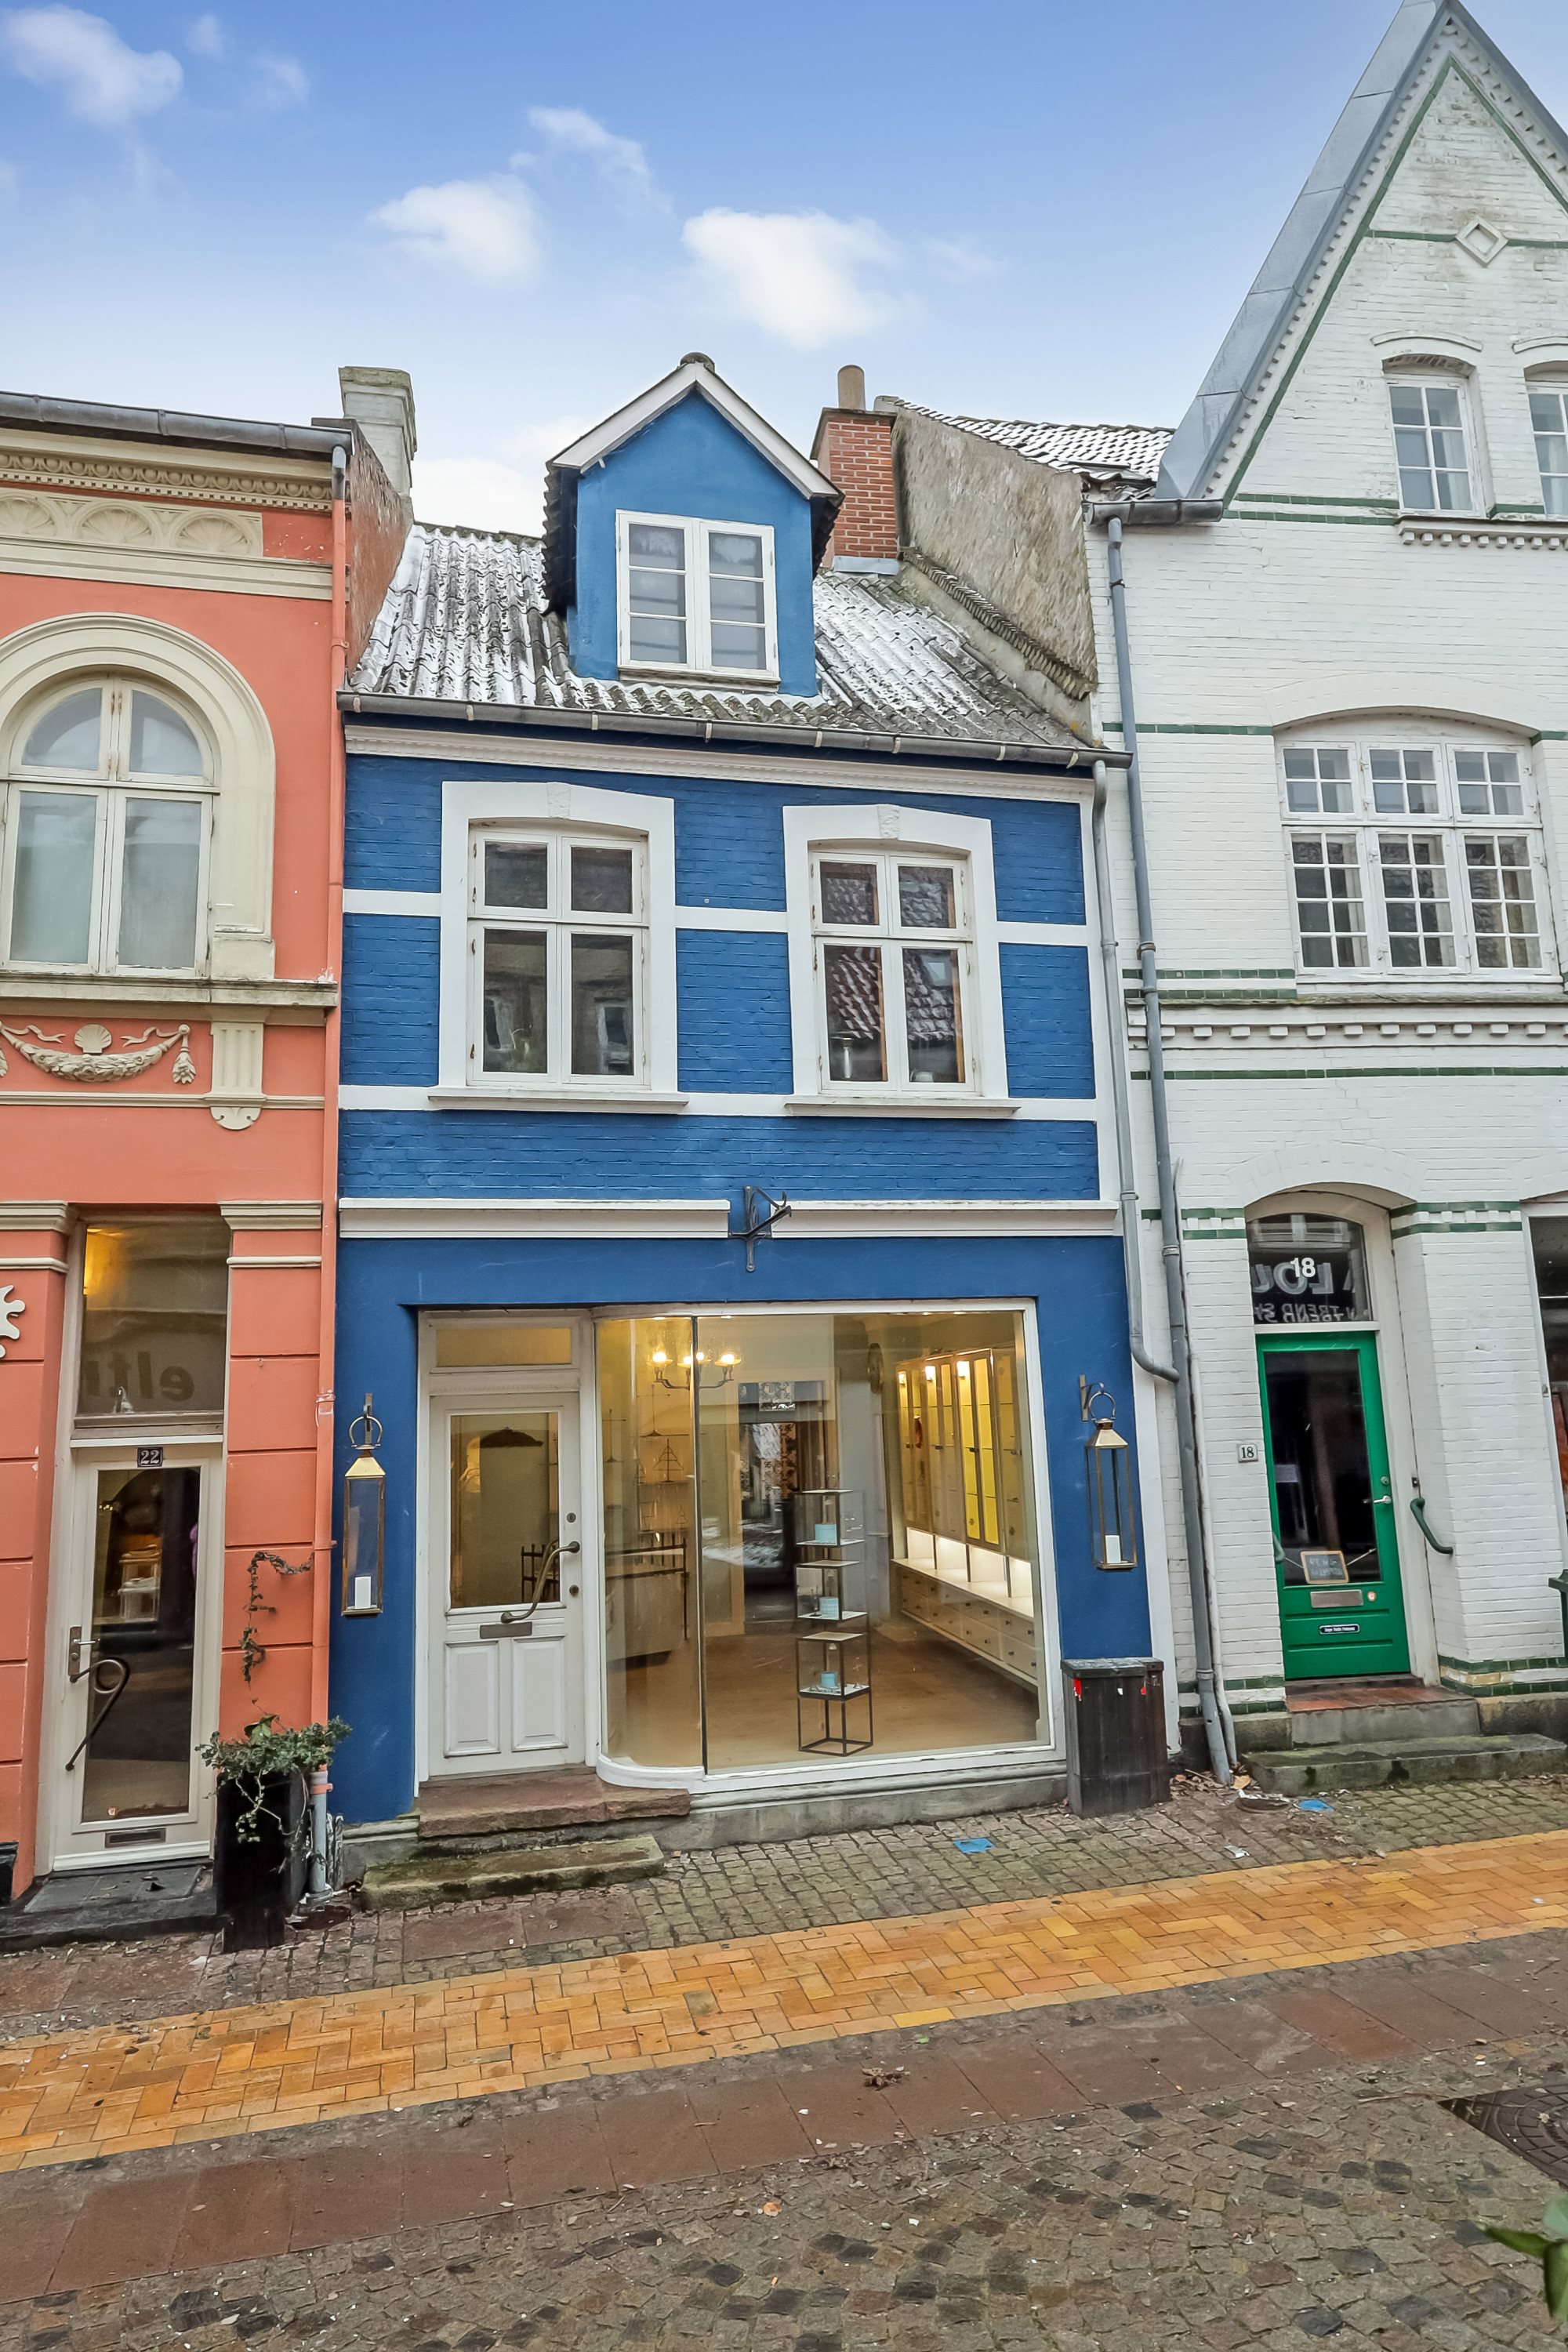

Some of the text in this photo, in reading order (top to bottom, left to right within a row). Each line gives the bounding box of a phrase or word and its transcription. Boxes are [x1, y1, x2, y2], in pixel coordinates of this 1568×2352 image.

[1290, 1257, 1316, 1277] 18
[140, 1450, 160, 1465] 22
[1241, 1446, 1254, 1459] 18
